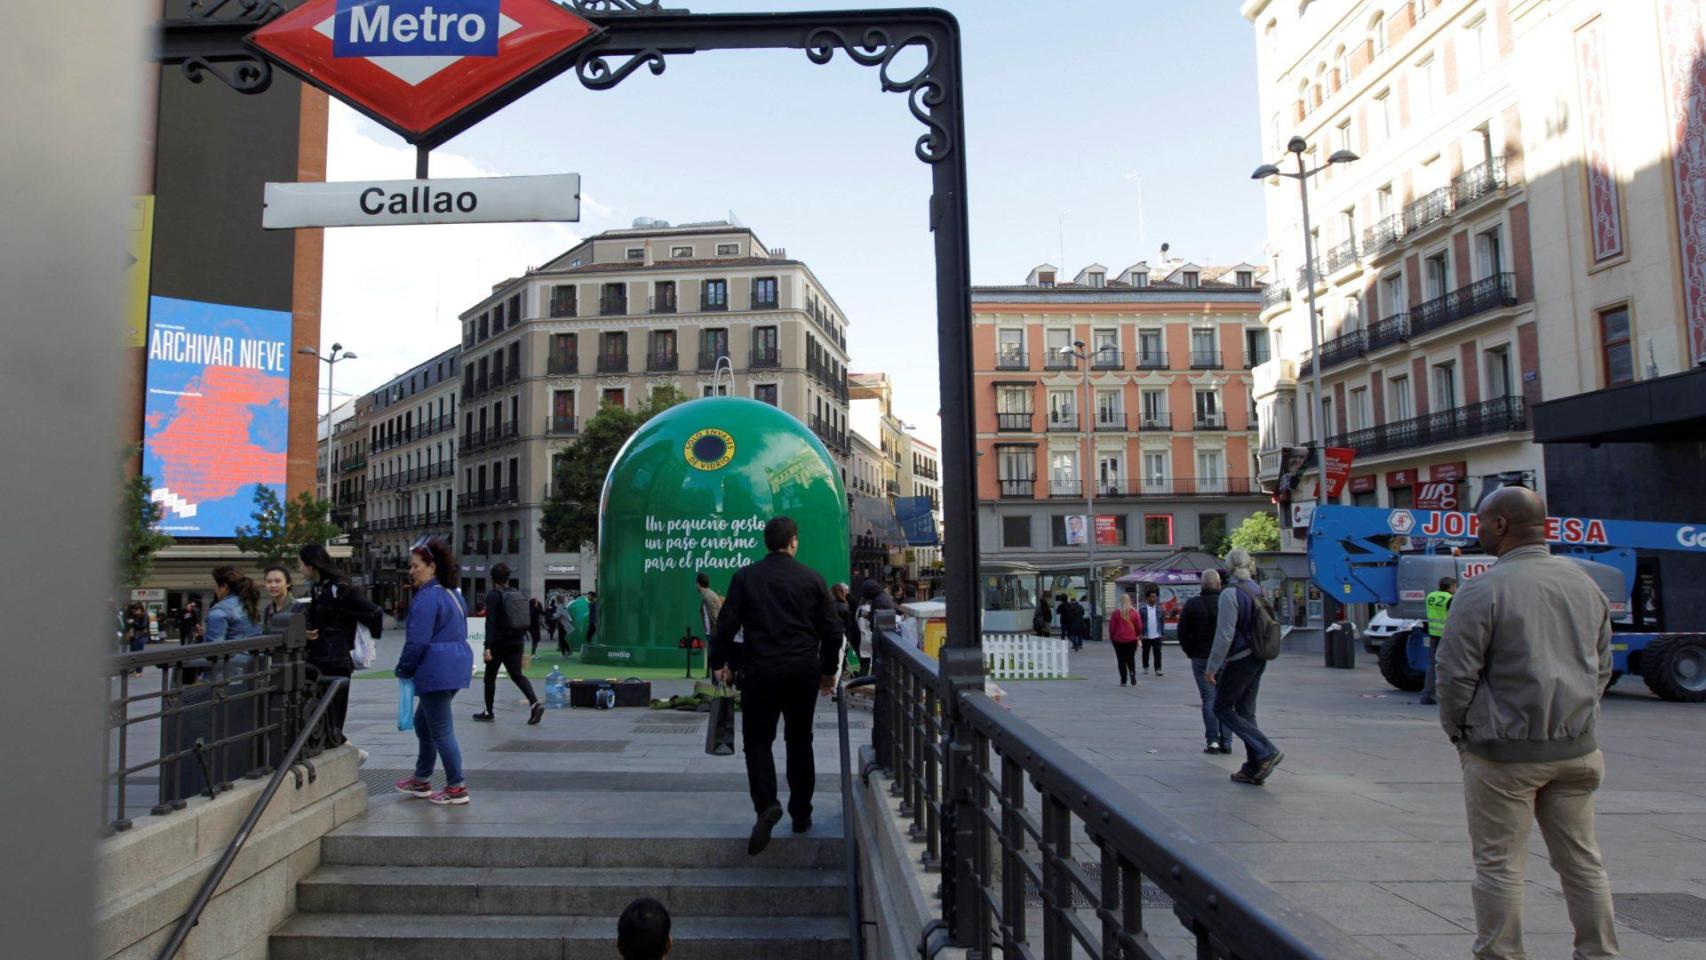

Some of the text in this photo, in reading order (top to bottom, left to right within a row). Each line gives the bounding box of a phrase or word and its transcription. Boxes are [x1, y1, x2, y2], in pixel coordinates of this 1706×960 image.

[350, 5, 486, 43] Metro
[360, 186, 478, 215] Callao
[150, 329, 285, 372] ARCHIVAR NIEVE
[645, 513, 766, 536] Un pequeño gesto
[645, 536, 757, 552] un paso enorme
[644, 556, 676, 573] para
[678, 550, 693, 569] el
